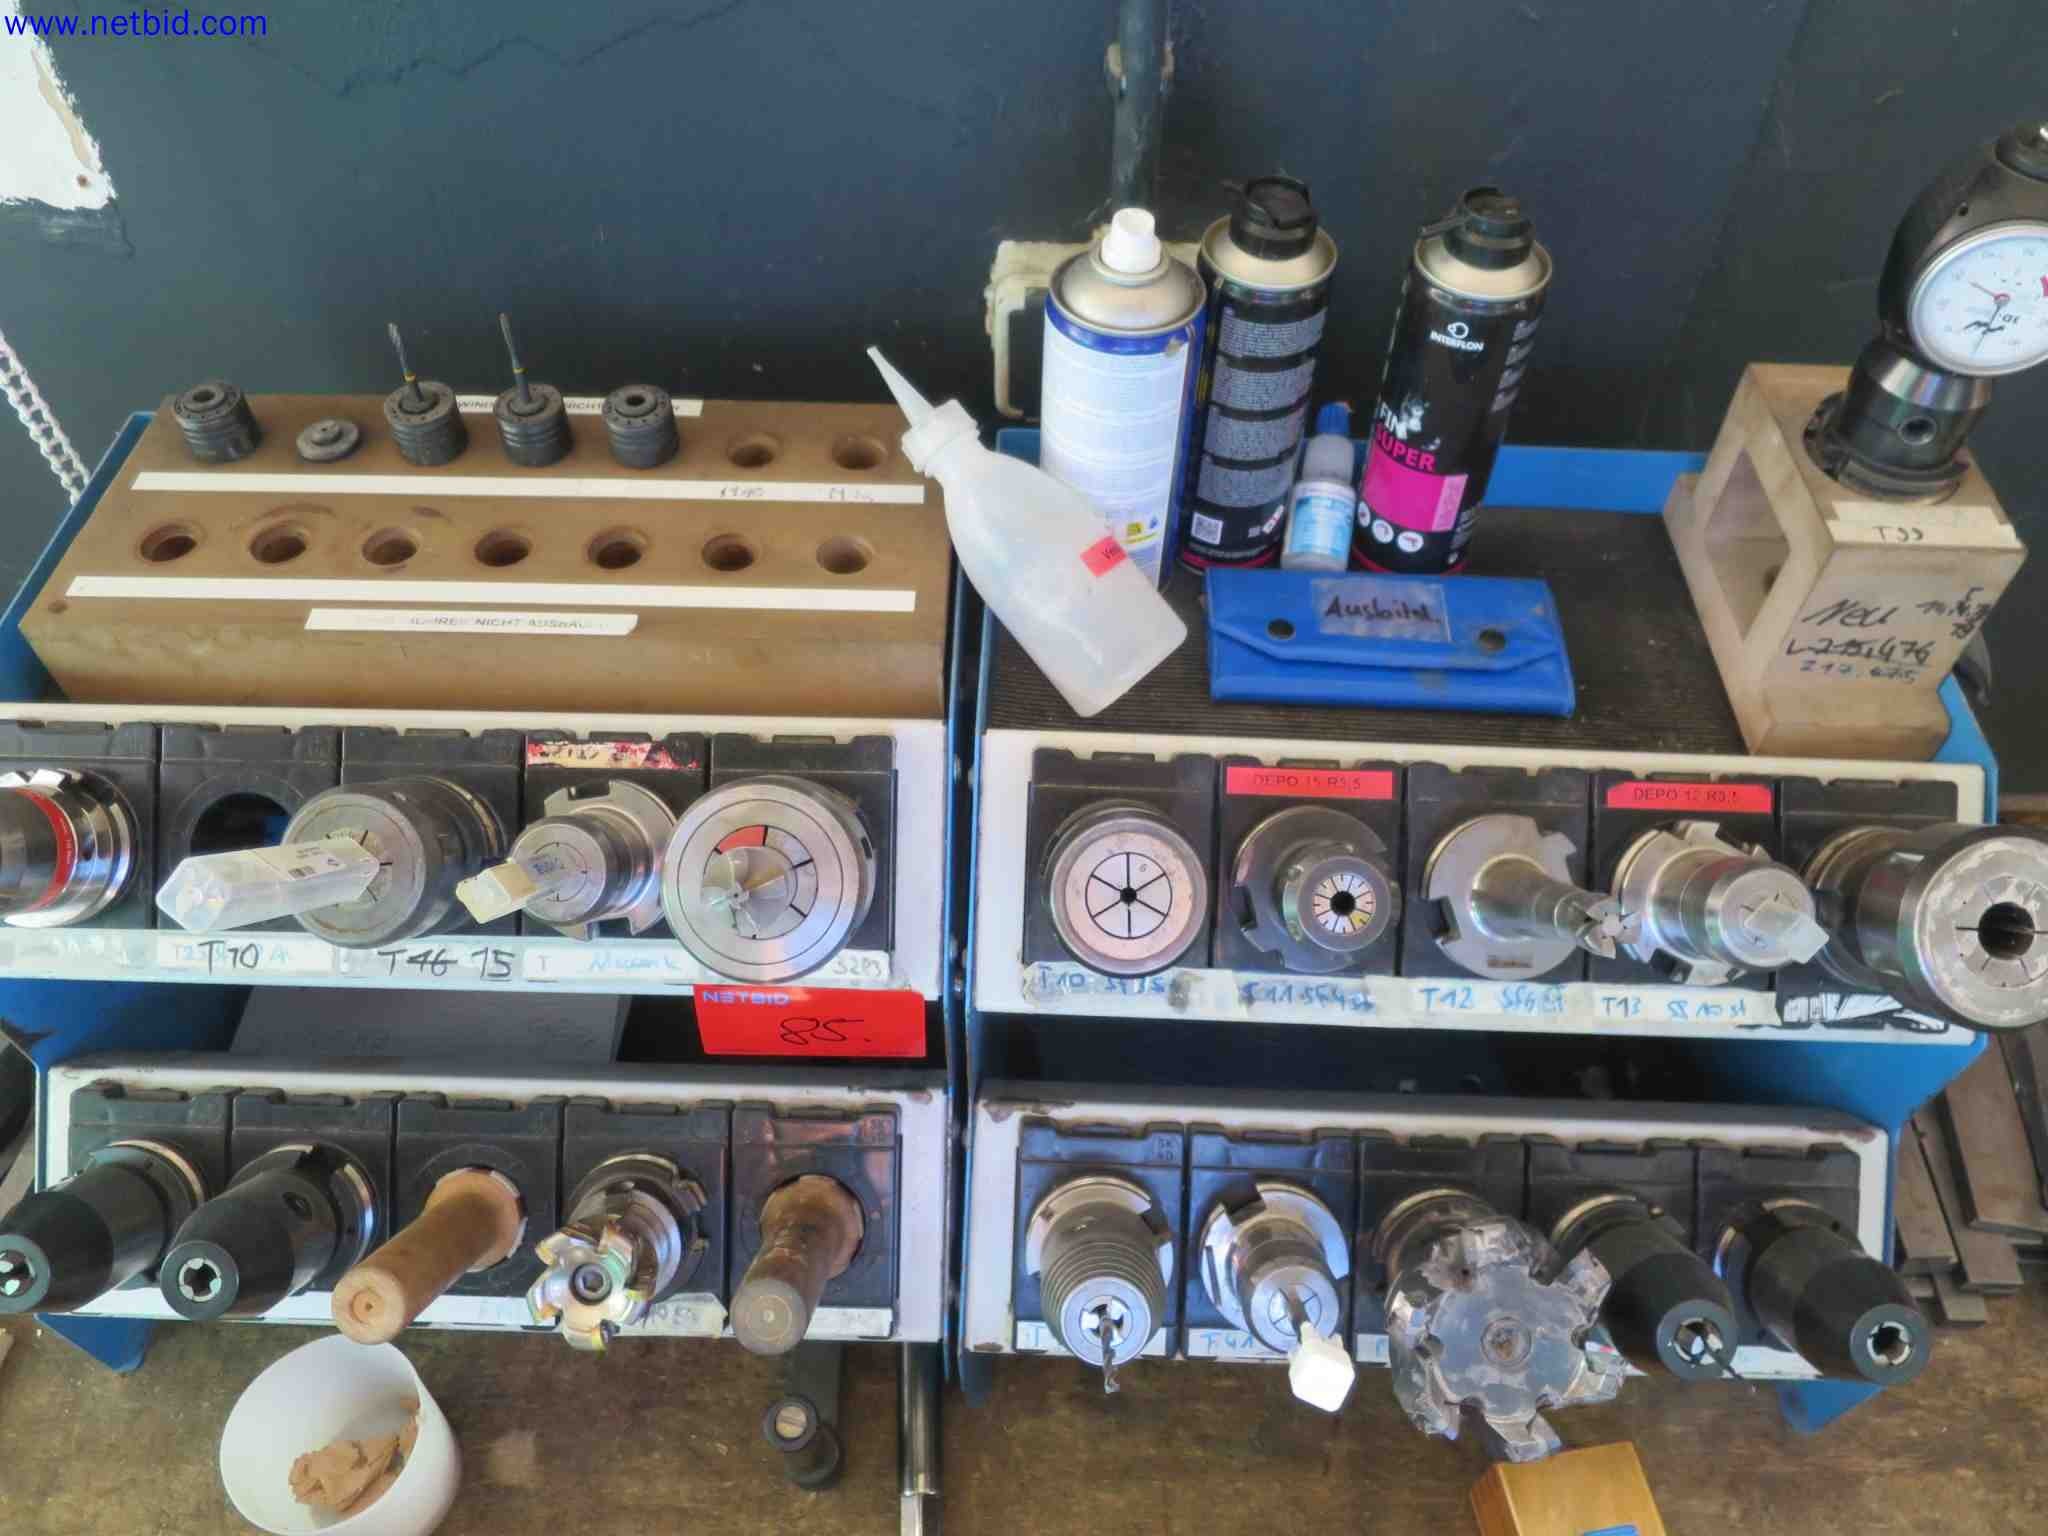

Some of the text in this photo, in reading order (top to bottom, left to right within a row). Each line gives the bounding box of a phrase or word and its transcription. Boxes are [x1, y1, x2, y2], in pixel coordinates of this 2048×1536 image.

[1254, 774, 1299, 786] DEPO
[1633, 787, 1678, 802] DEPO
[703, 990, 790, 1005] NETBID
